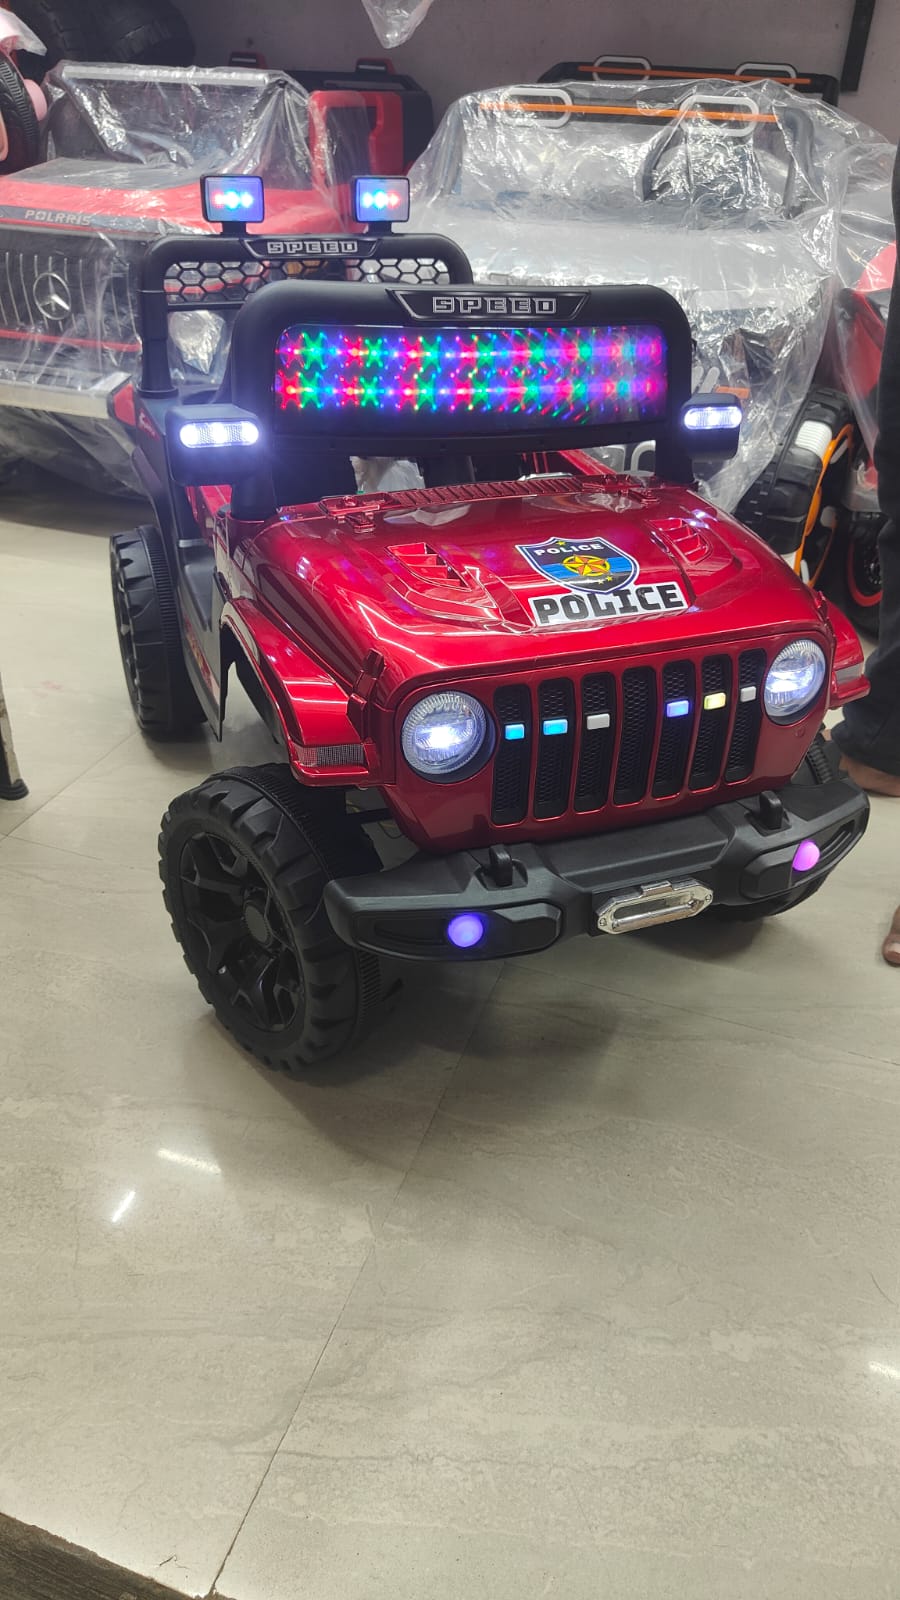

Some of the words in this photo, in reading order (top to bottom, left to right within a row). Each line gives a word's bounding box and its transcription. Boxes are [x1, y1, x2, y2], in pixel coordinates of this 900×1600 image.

[267, 241, 358, 254] SPEED
[432, 297, 557, 314] SPEED
[535, 543, 605, 557] POLICE
[533, 584, 684, 624] POLICE
